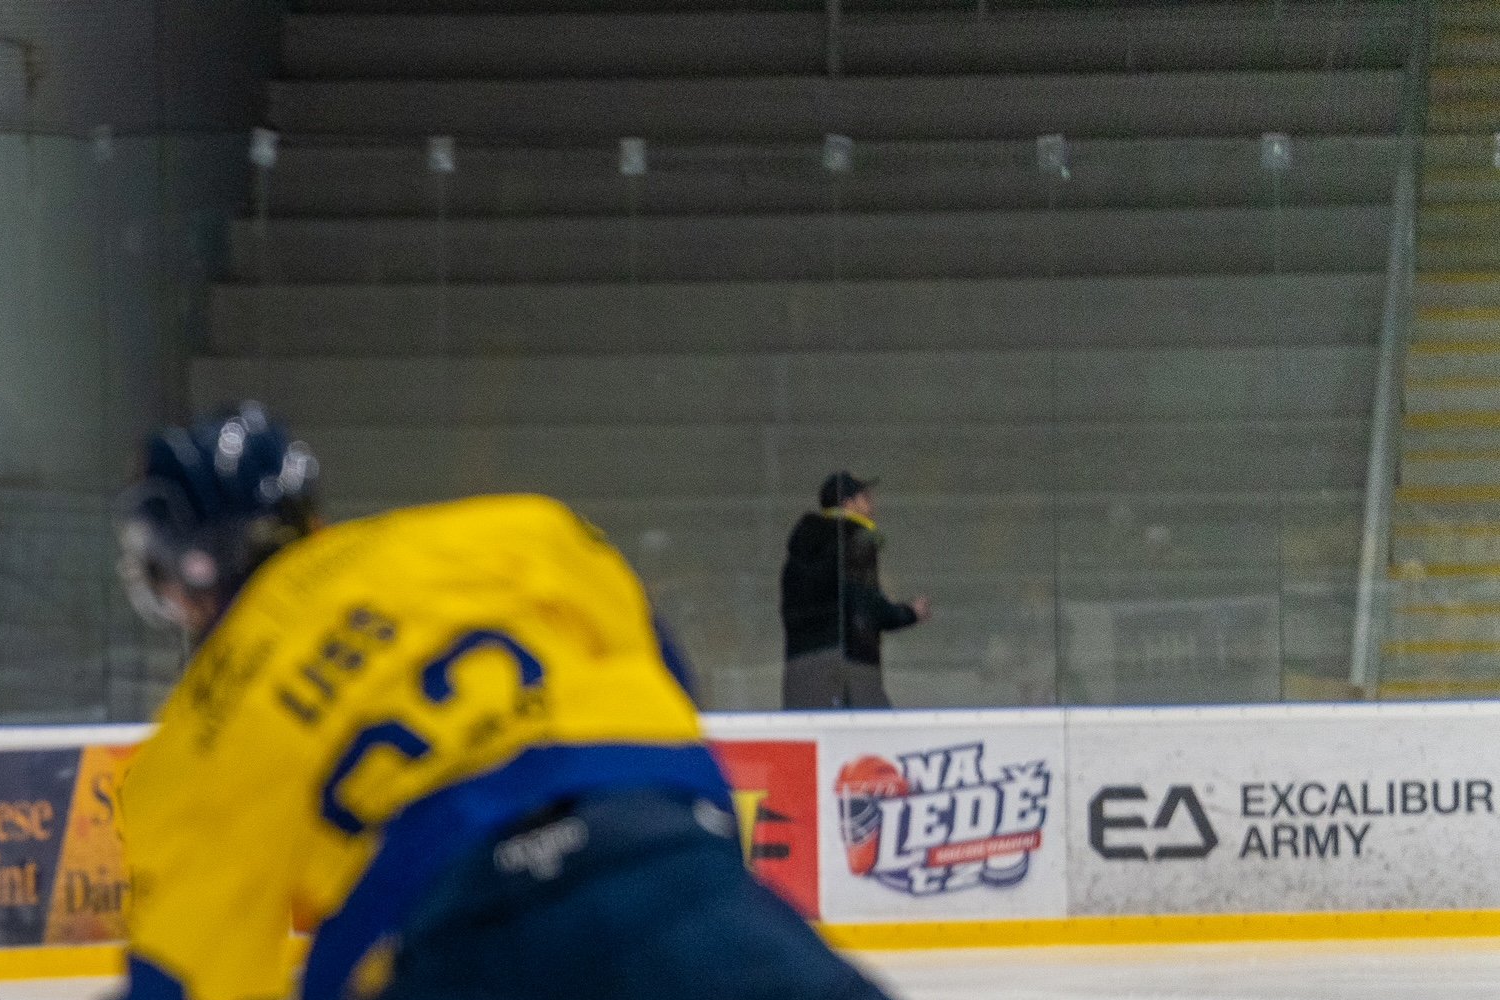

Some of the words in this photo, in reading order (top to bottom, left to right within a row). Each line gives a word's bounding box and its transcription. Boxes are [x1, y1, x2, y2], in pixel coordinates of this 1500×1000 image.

[900, 742, 982, 794] NA
[1240, 780, 1493, 818] EXCALIBUR
[1239, 823, 1372, 860] ARMY
